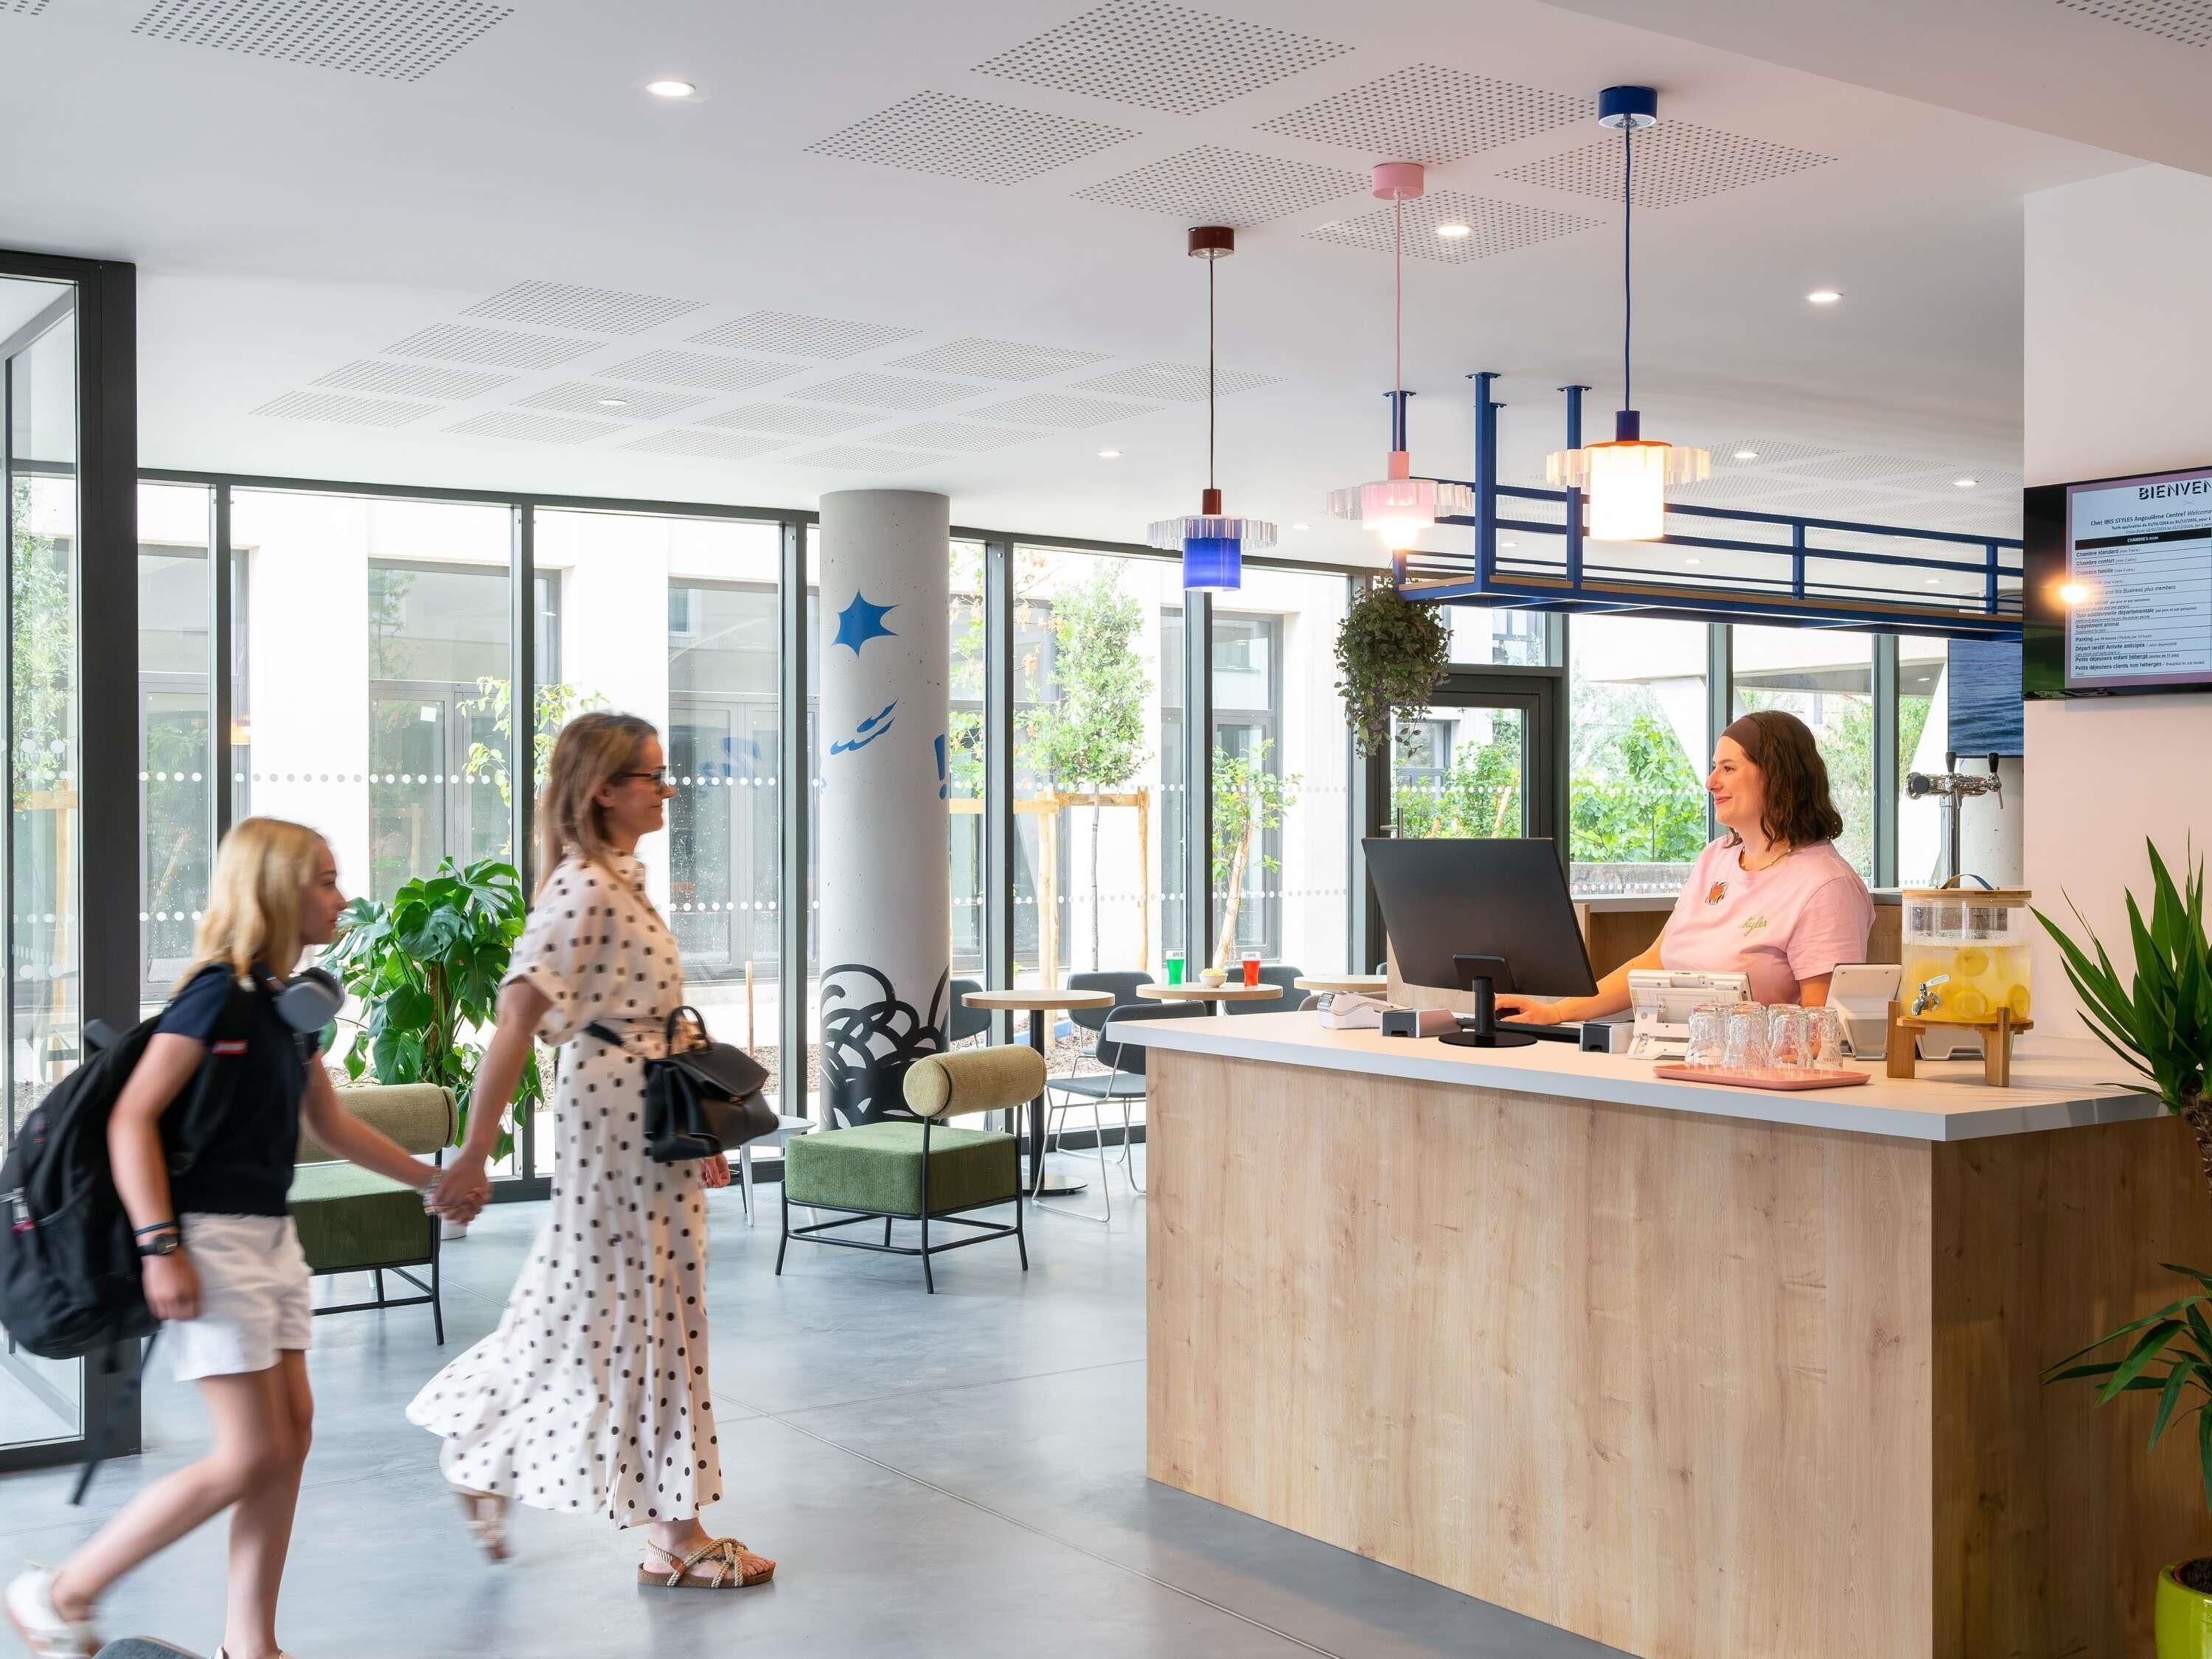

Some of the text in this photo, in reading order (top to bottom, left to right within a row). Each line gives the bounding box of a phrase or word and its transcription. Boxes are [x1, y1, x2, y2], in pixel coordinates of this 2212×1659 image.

[2134, 513, 2165, 522] Angoulême
[2118, 608, 2154, 616] départementale
[1739, 916, 1767, 937] styles
